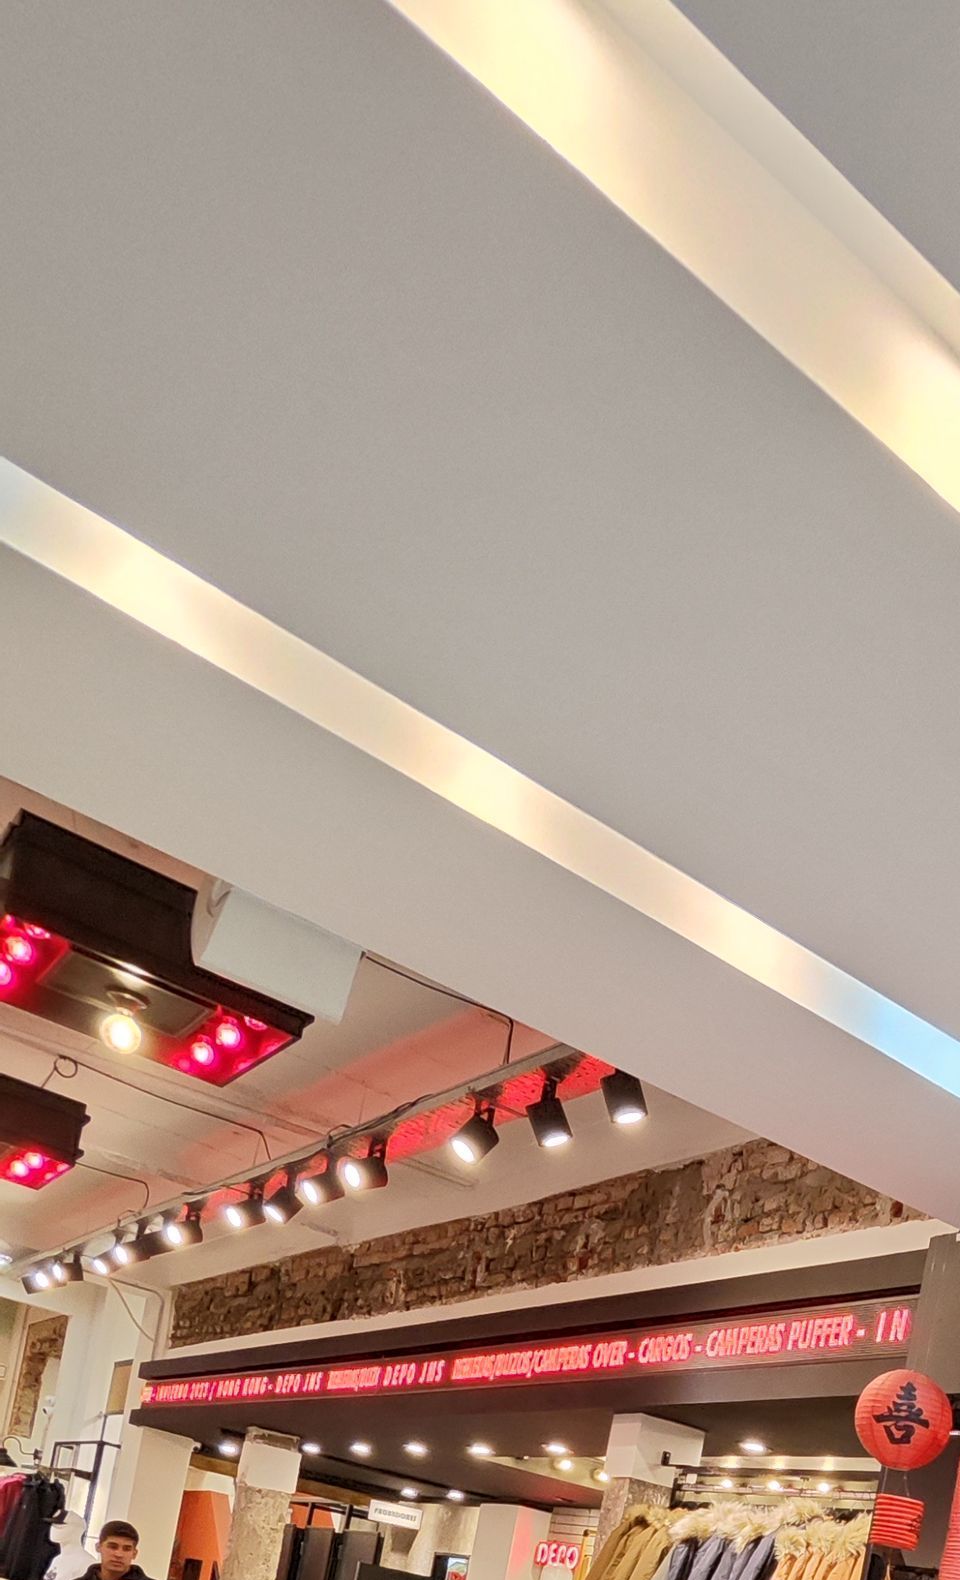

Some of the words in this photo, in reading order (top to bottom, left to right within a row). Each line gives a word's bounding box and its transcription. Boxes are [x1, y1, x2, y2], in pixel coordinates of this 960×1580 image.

[382, 1362, 417, 1387] DEPO
[592, 1340, 628, 1368] OVER
[638, 1332, 693, 1364] CARGOS
[706, 1322, 786, 1357] CAMPERAS
[786, 1313, 855, 1350] PUFFER
[536, 1542, 580, 1570] DEPO
